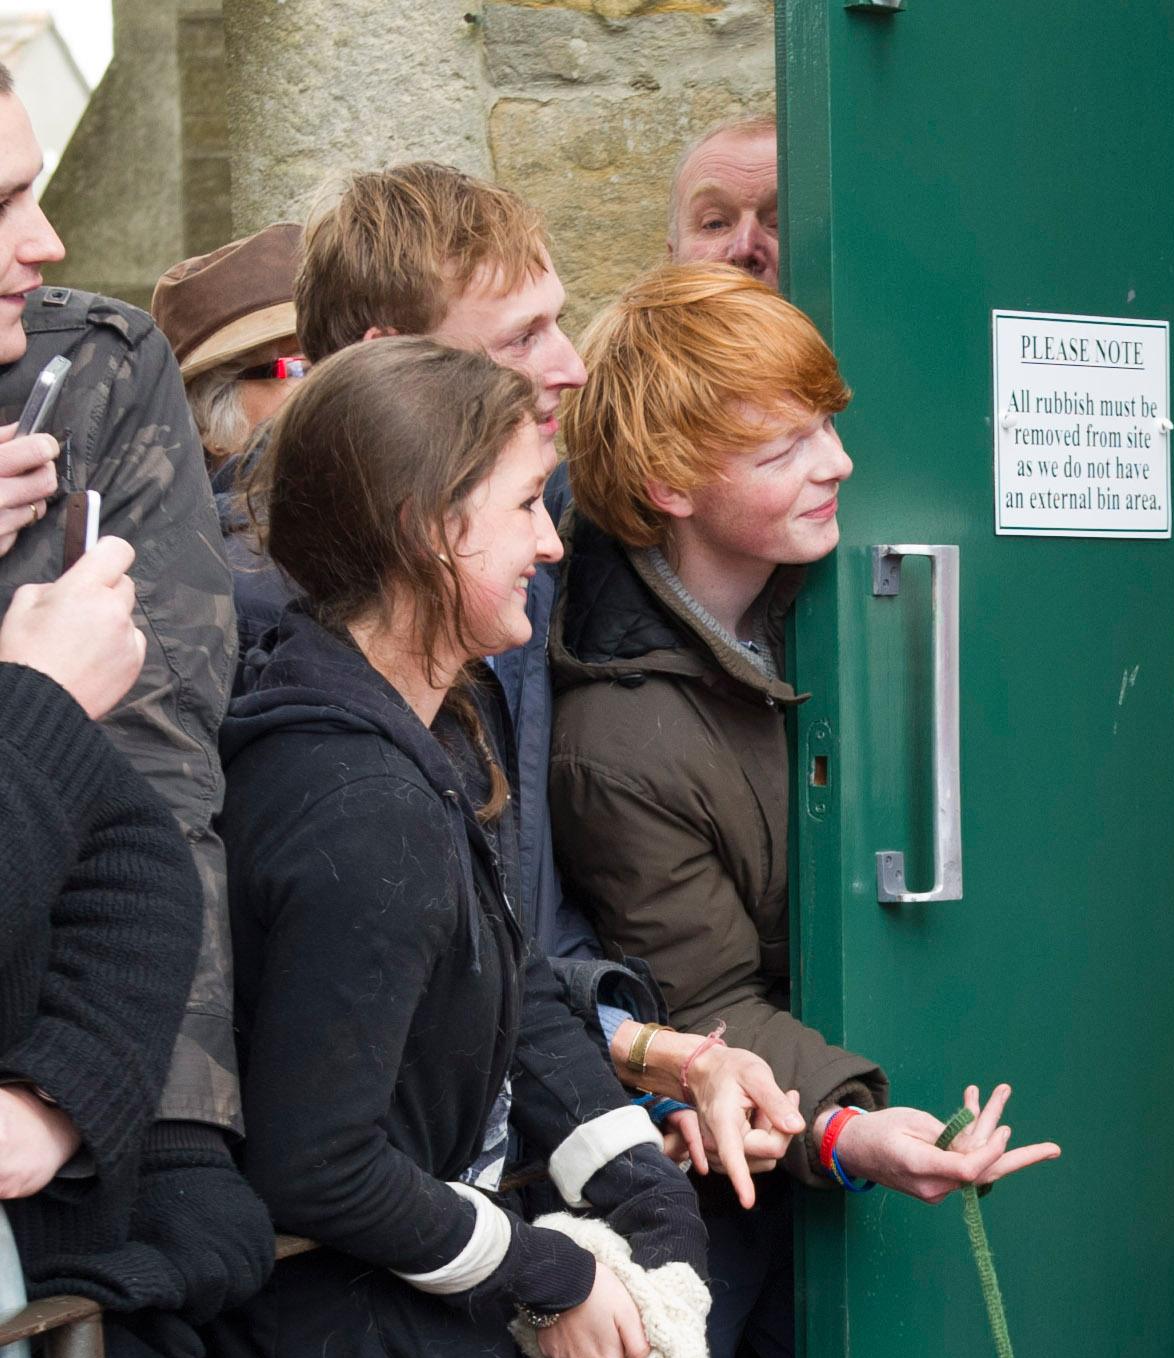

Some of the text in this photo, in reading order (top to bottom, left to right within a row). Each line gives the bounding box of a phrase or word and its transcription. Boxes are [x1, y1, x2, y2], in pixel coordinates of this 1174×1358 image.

[1020, 335, 1144, 366] PLEASE NOTE
[1007, 389, 1158, 419] All rubbish must be
[1014, 423, 1151, 449] removed from site
[1017, 455, 1150, 481] as we do not have
[1005, 487, 1162, 511] an external bin area.
